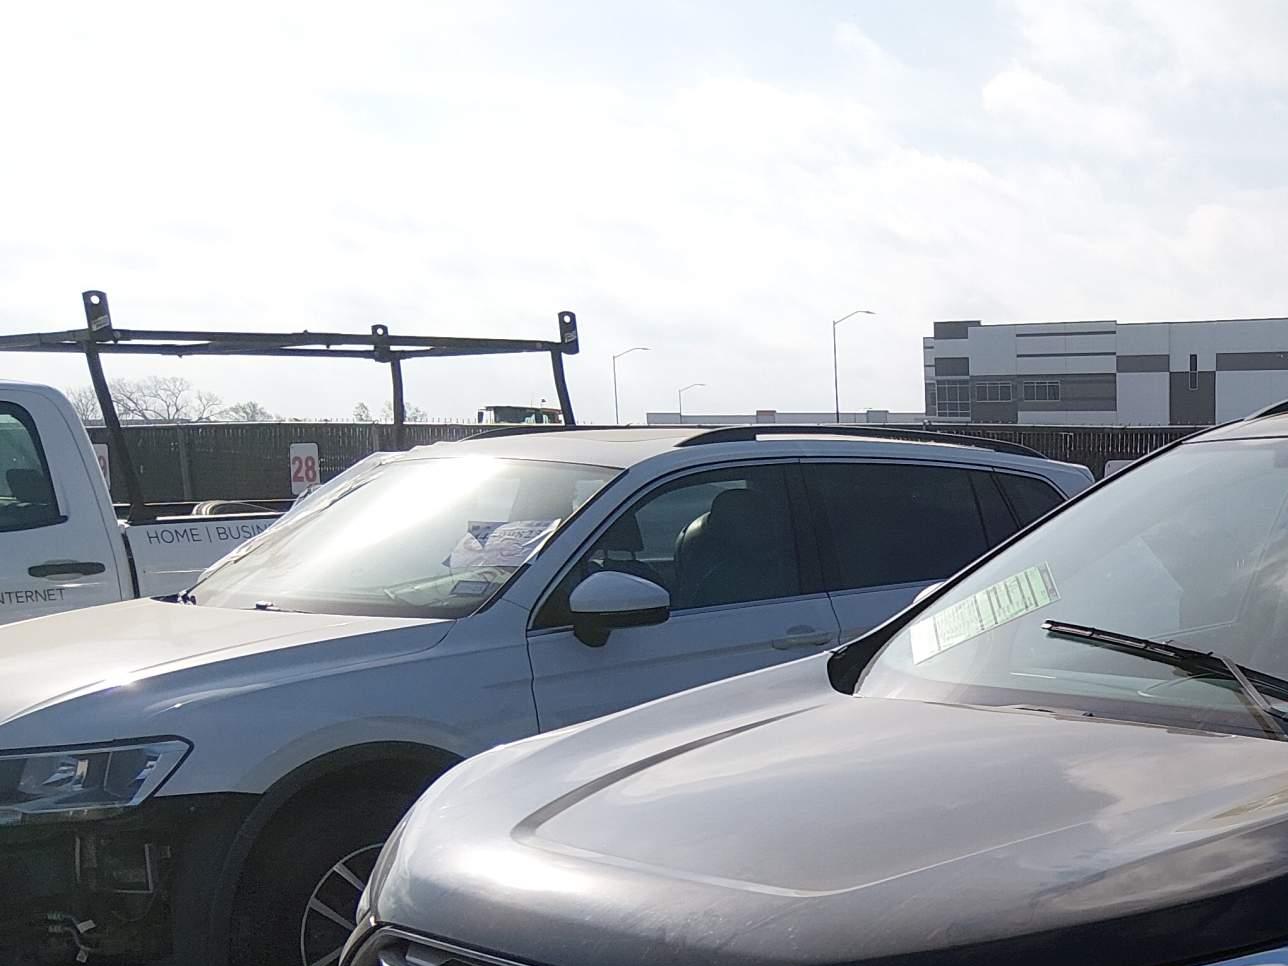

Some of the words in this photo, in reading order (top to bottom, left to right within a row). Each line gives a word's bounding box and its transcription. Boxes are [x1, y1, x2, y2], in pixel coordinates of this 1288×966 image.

[292, 456, 317, 482] 28
[146, 527, 201, 545] HOME
[216, 524, 273, 541] BUSIN
